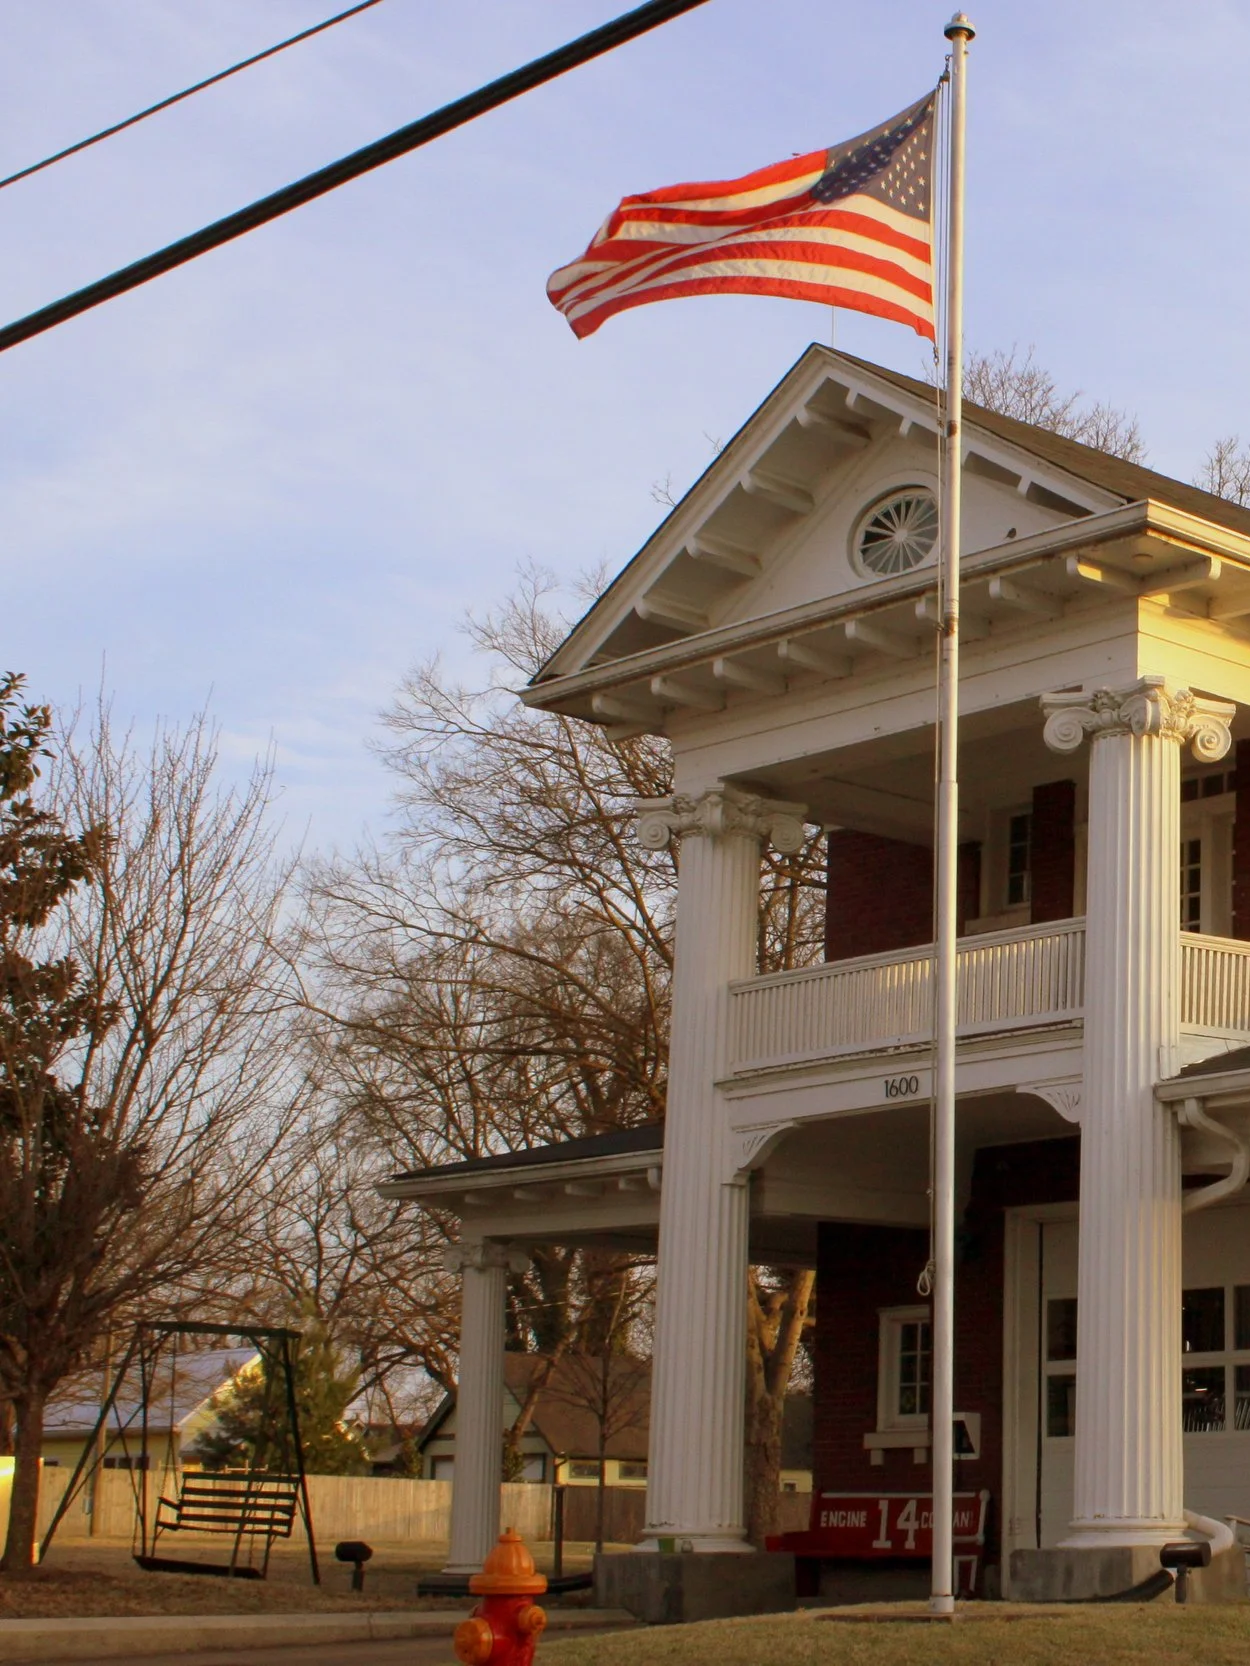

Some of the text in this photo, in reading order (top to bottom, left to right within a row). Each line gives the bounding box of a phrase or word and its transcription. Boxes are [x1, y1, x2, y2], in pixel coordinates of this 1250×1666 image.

[884, 1075, 919, 1098] 1600
[820, 1510, 867, 1528] ENGINE
[872, 1499, 919, 1550] 14
